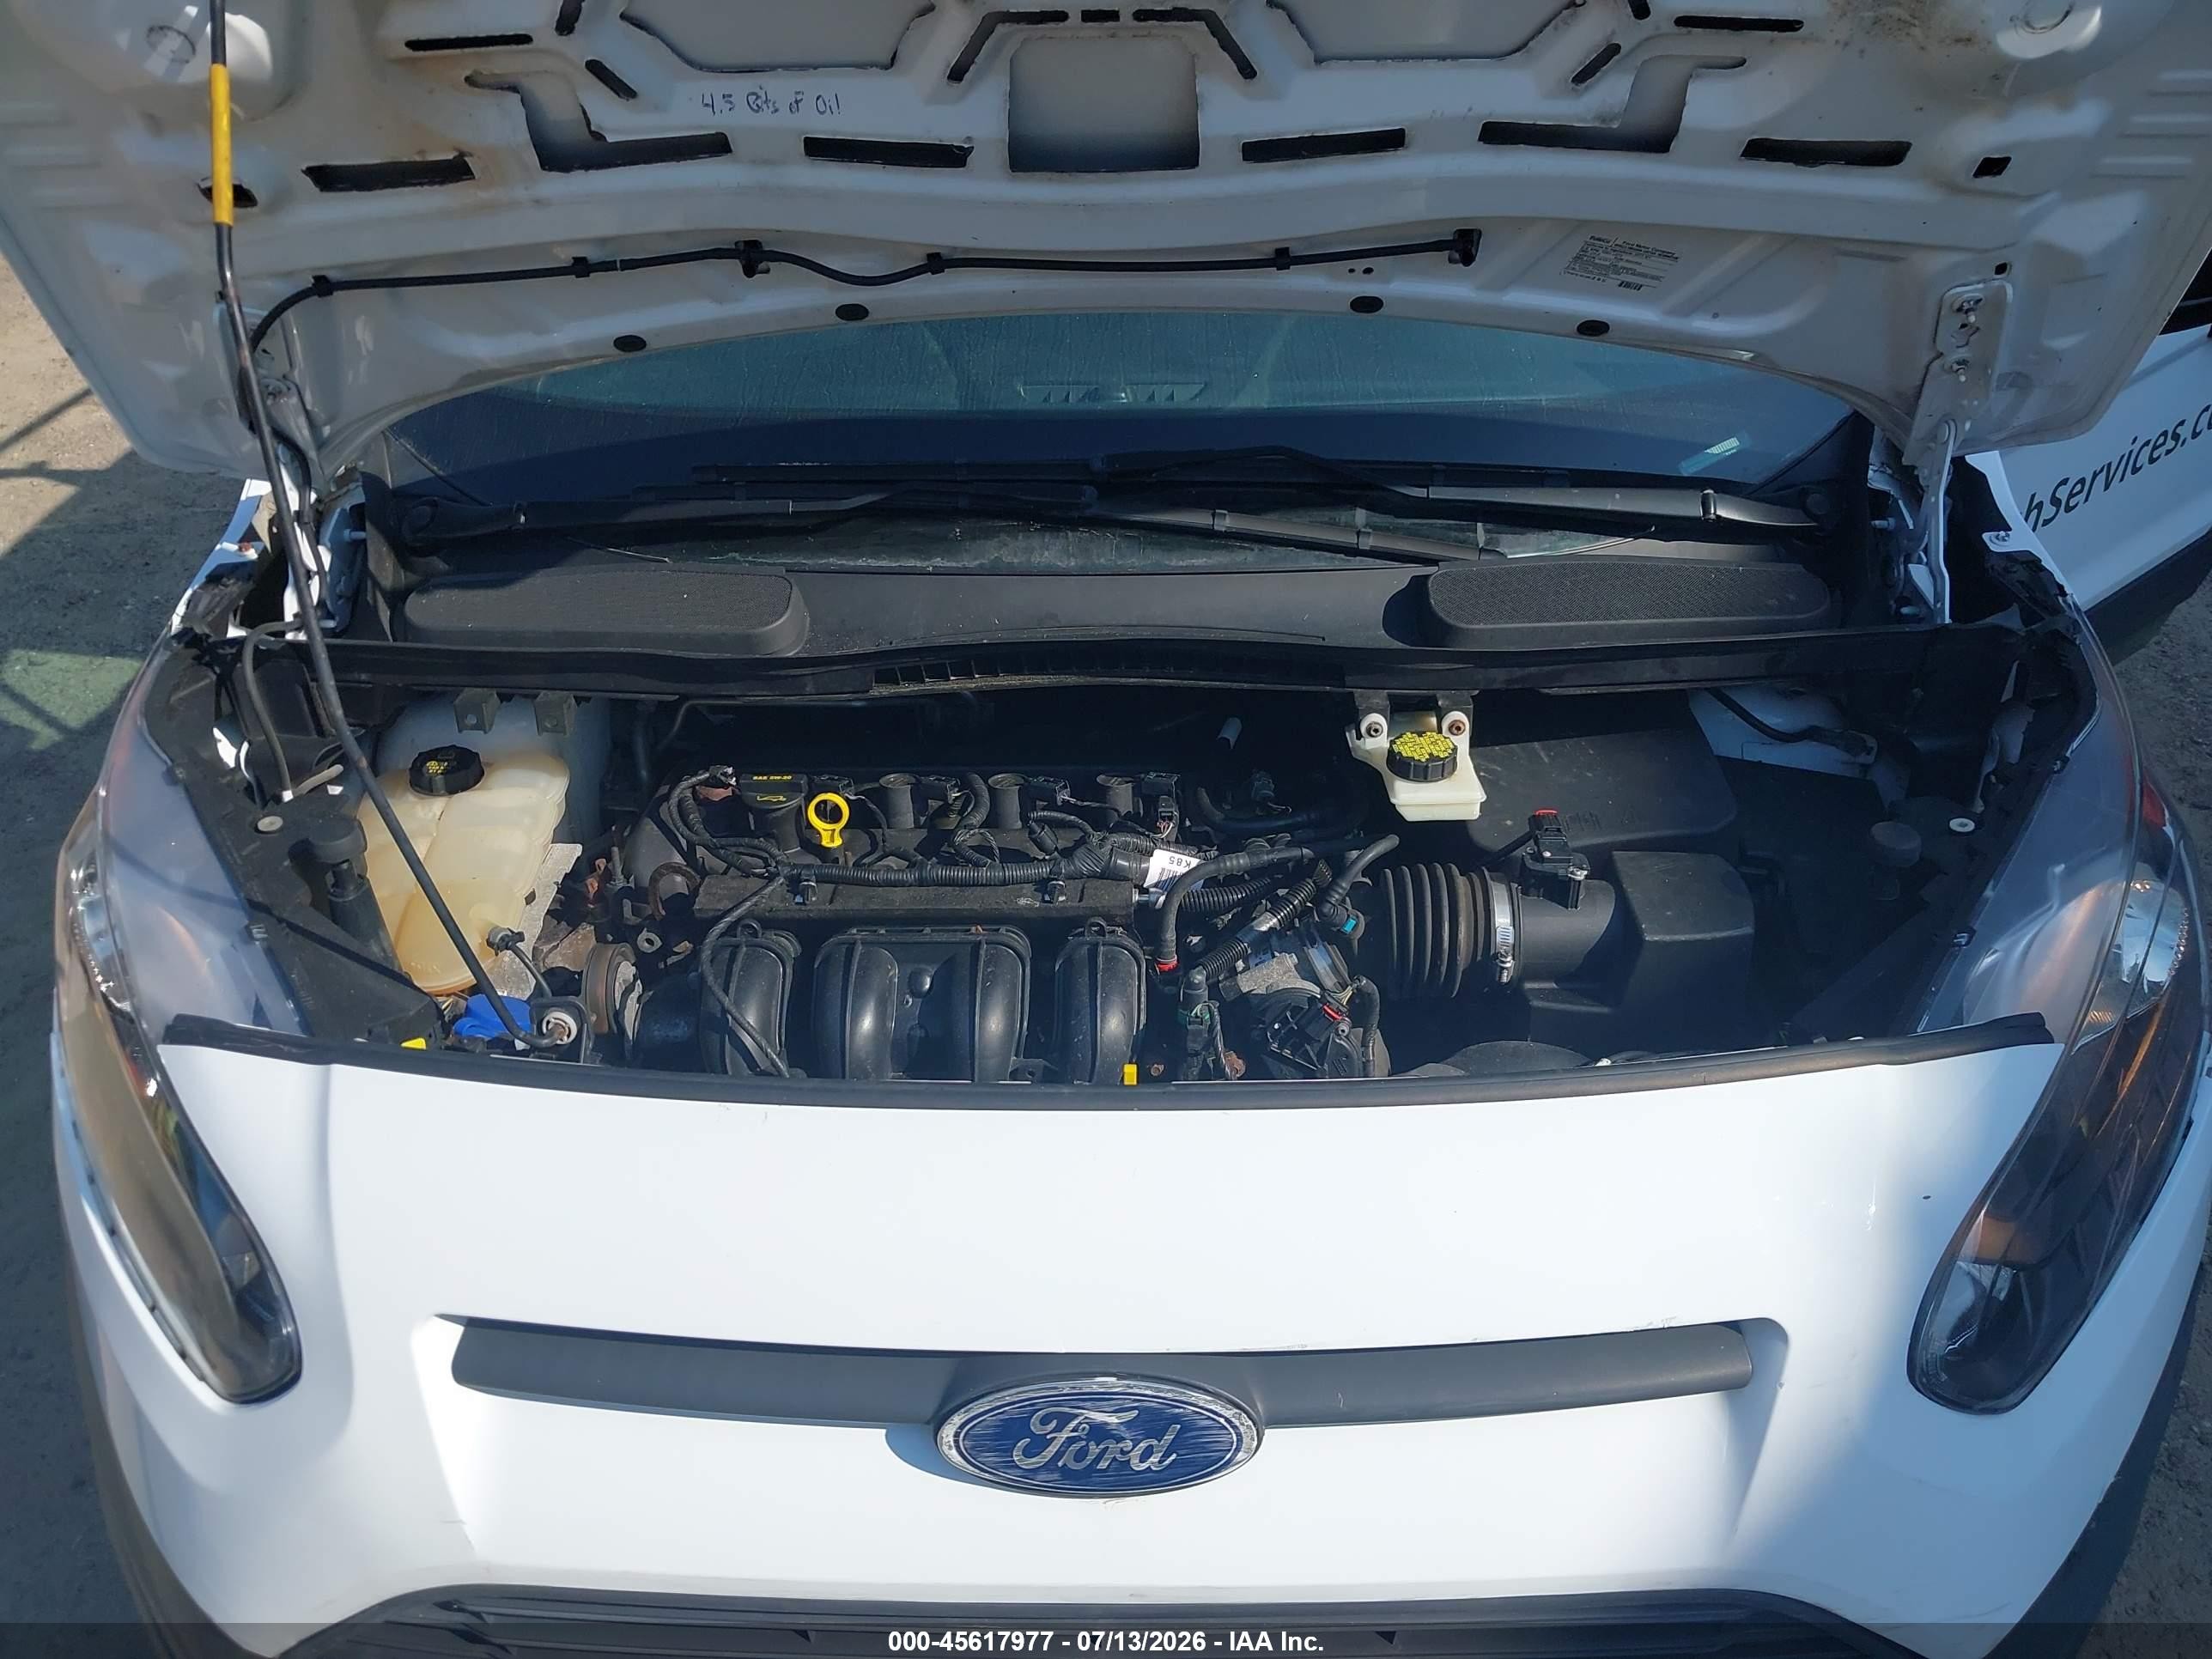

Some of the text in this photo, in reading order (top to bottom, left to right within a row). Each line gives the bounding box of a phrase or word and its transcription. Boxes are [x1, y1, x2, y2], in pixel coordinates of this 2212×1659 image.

[702, 92, 736, 116] 4.5
[2023, 404, 2212, 533] hServices.c
[1012, 1407, 1182, 1471] Ford
